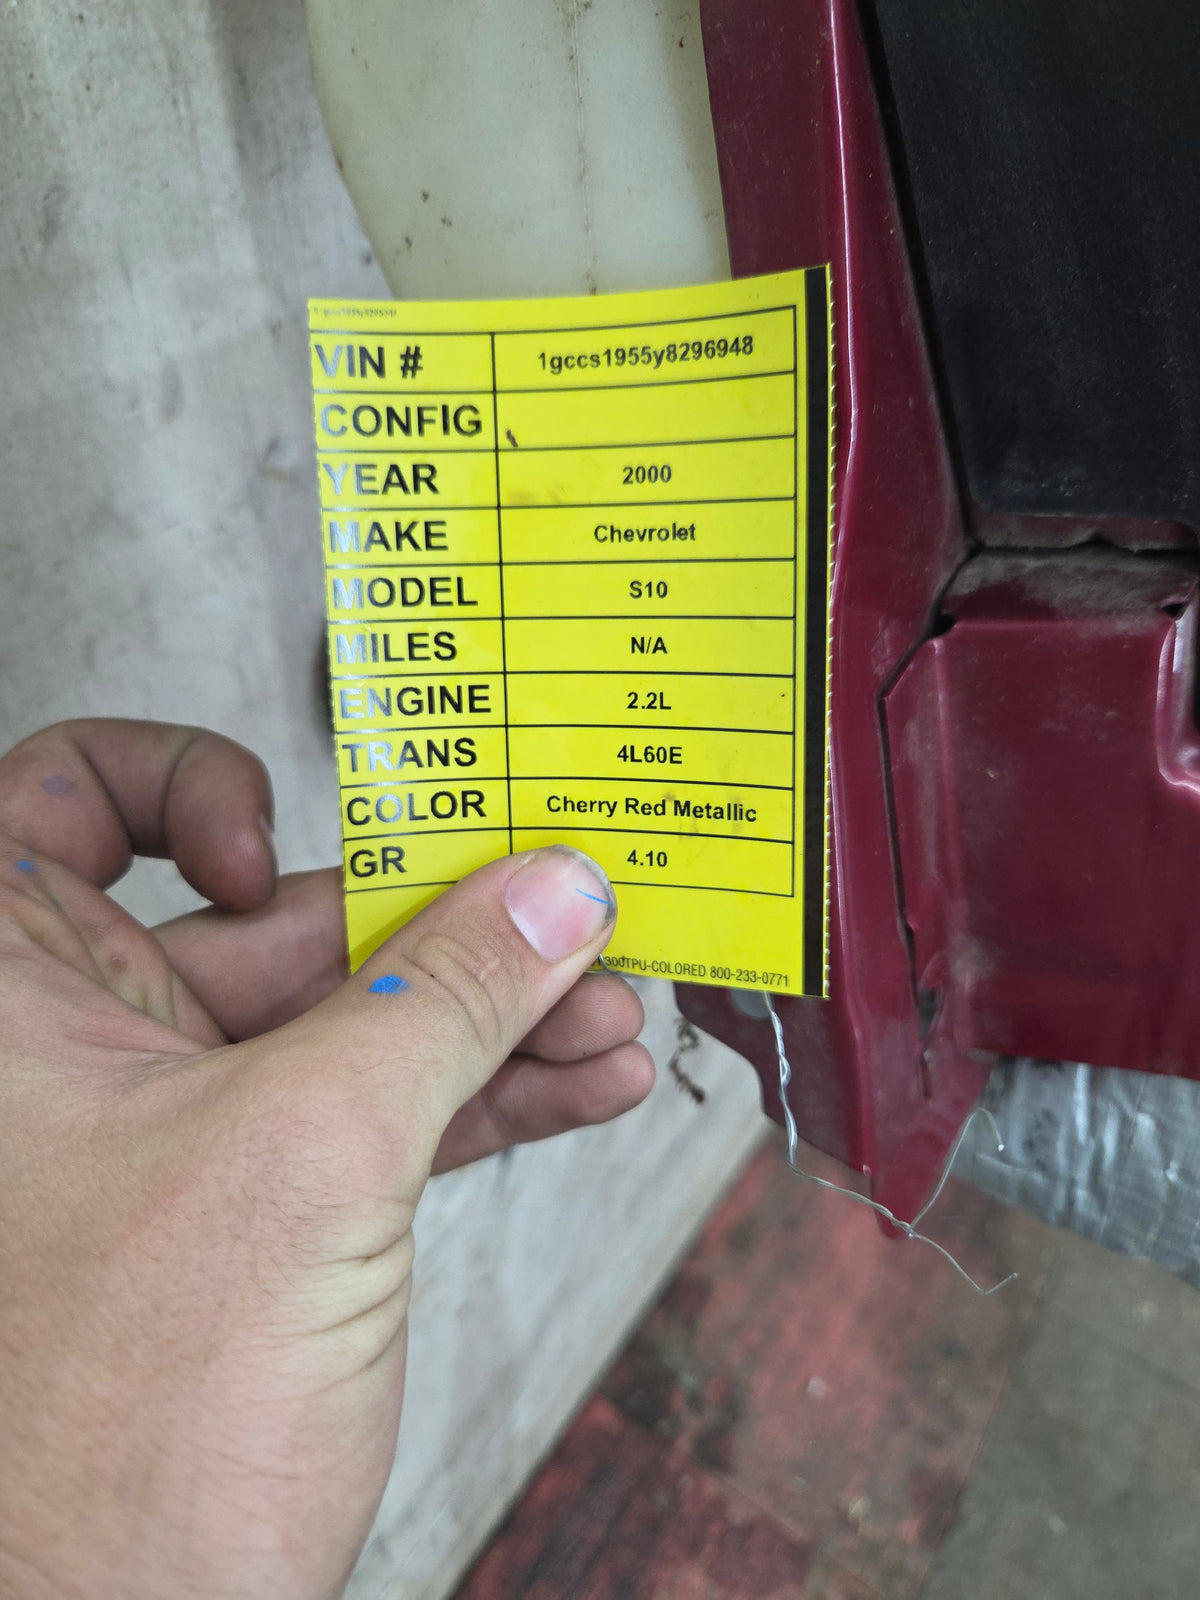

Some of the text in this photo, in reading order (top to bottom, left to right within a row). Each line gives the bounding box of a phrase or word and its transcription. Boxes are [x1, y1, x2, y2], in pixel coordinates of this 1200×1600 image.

[314, 343, 423, 379] VIN #
[538, 335, 754, 374] 1gccs1955y8296948
[321, 404, 482, 437] CONFIG
[323, 463, 440, 496] YEAR
[622, 464, 672, 485] 2000
[329, 520, 449, 553] MAKE
[594, 522, 696, 543] Chevrolet
[333, 576, 478, 609] MODEL
[629, 580, 668, 599] S10
[336, 631, 458, 664] MILES
[630, 635, 668, 655] N/A
[340, 684, 491, 719] ENGINE
[627, 691, 672, 711] 2.2L
[342, 737, 478, 773] TRANS
[617, 745, 683, 765] 4L60E
[347, 789, 487, 826] COLOR
[547, 795, 757, 823] Cherry Red Metallic
[350, 845, 408, 878] GR
[627, 849, 668, 868] 4.10
[710, 967, 789, 987] 800-233-0771
